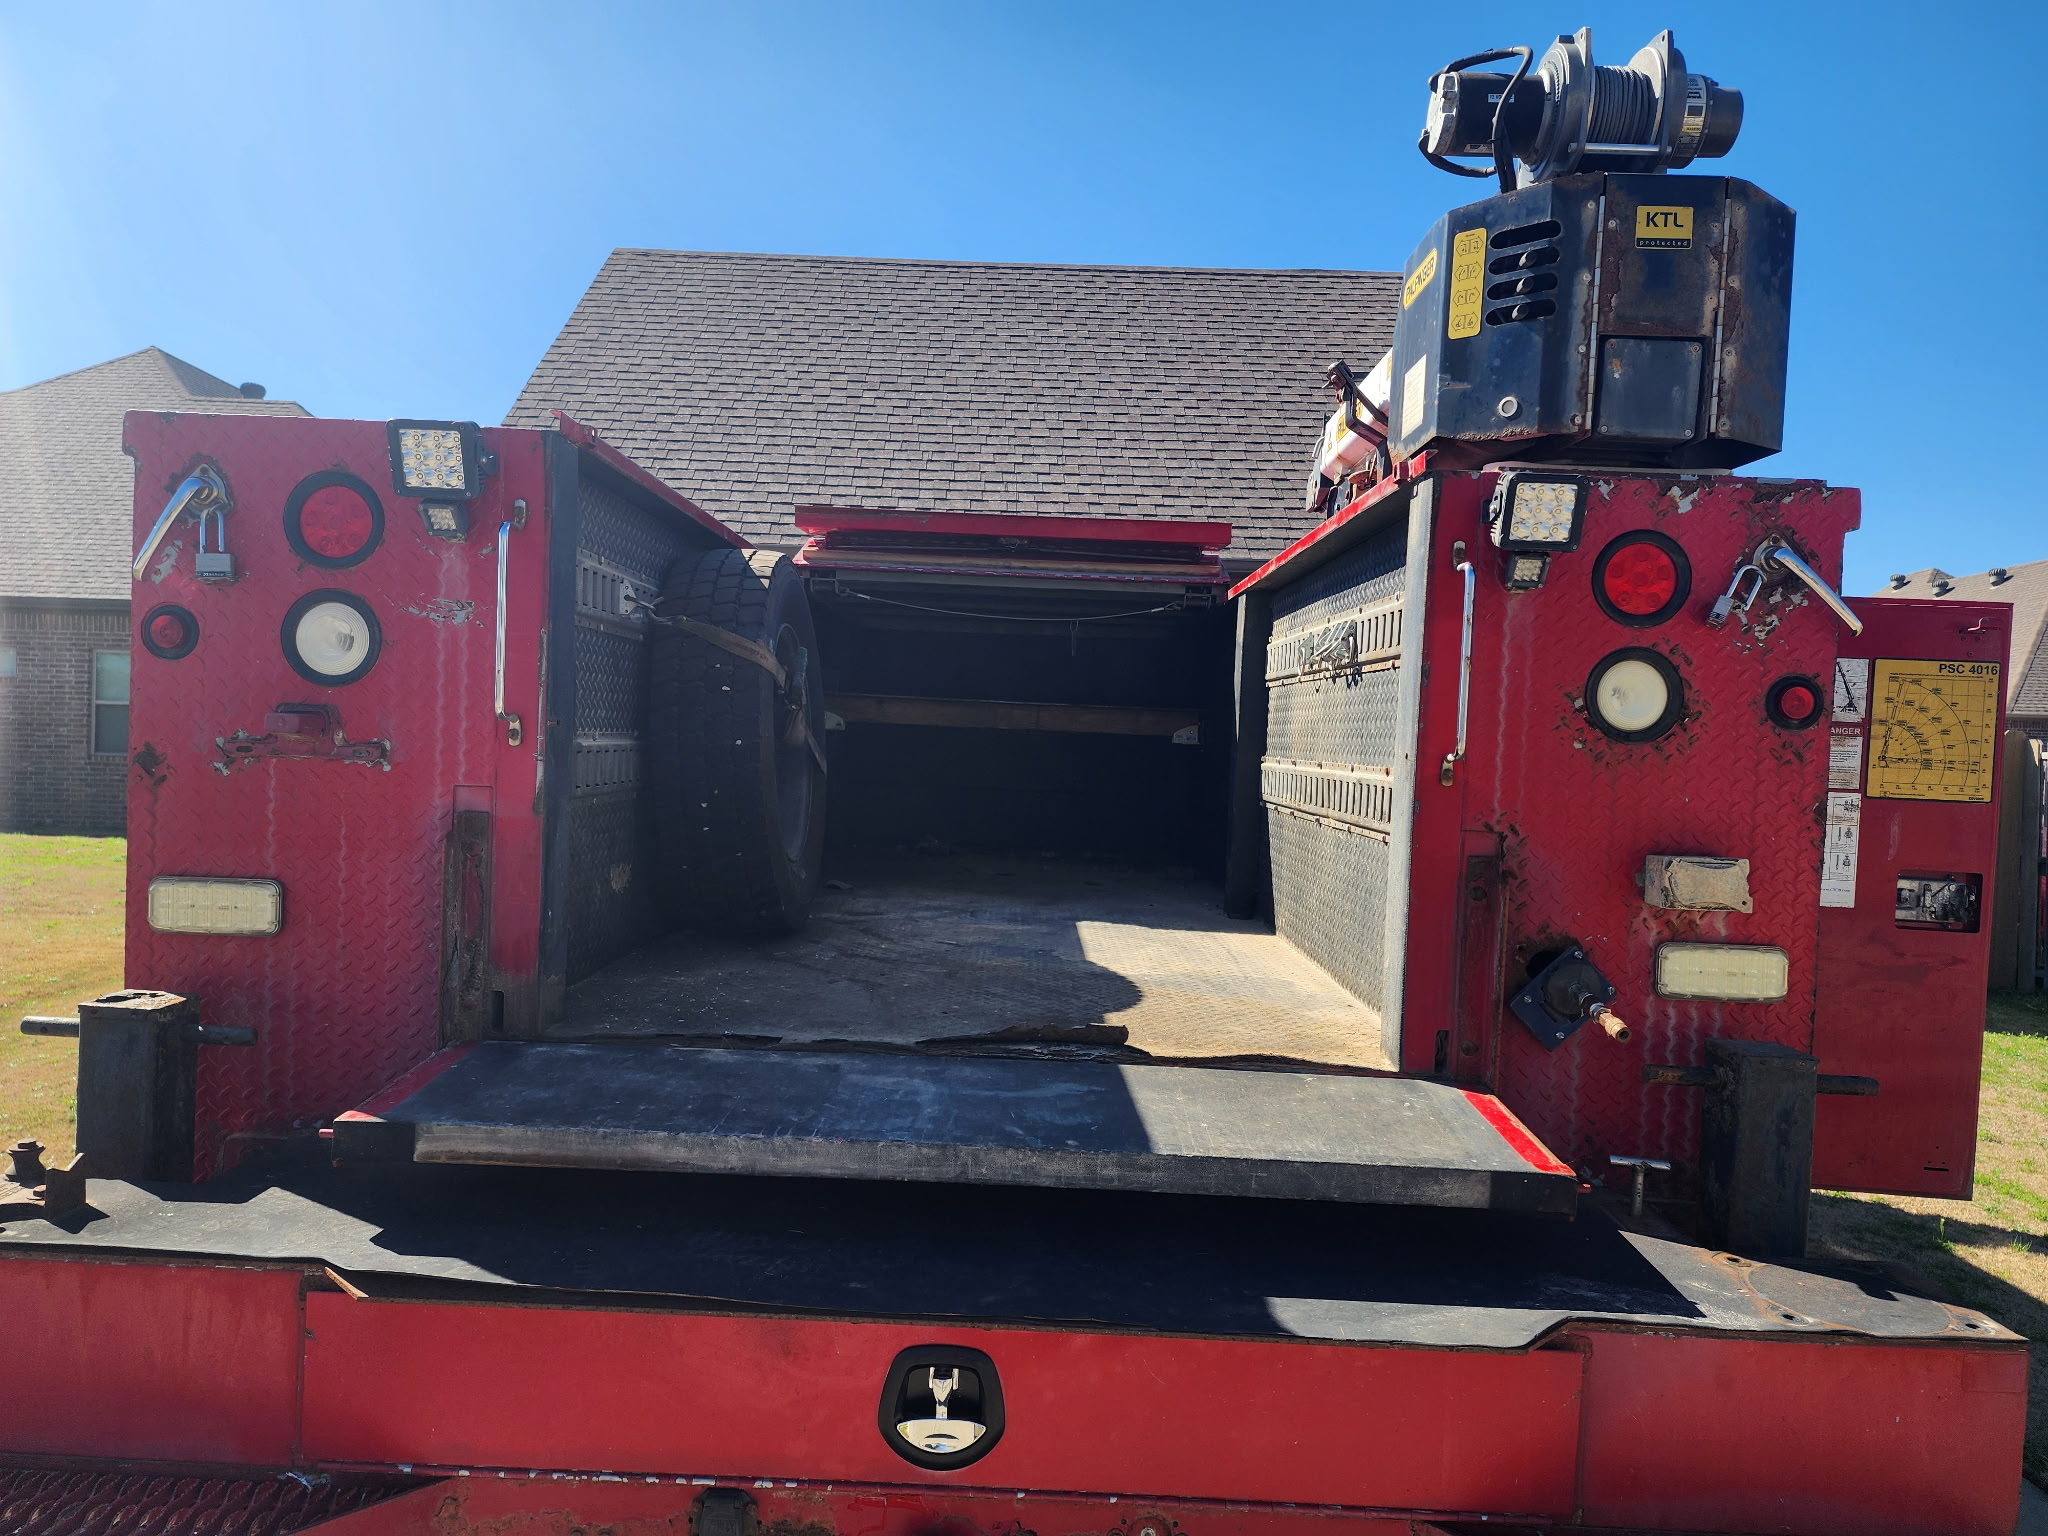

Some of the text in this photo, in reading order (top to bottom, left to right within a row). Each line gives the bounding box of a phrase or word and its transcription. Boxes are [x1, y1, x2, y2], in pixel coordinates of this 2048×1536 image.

[1646, 211, 1684, 228] KTL
[1639, 239, 1688, 247] protected
[1939, 663, 1966, 675] PSC
[1968, 664, 1999, 676] 4016
[1831, 726, 1861, 735] ANGER
